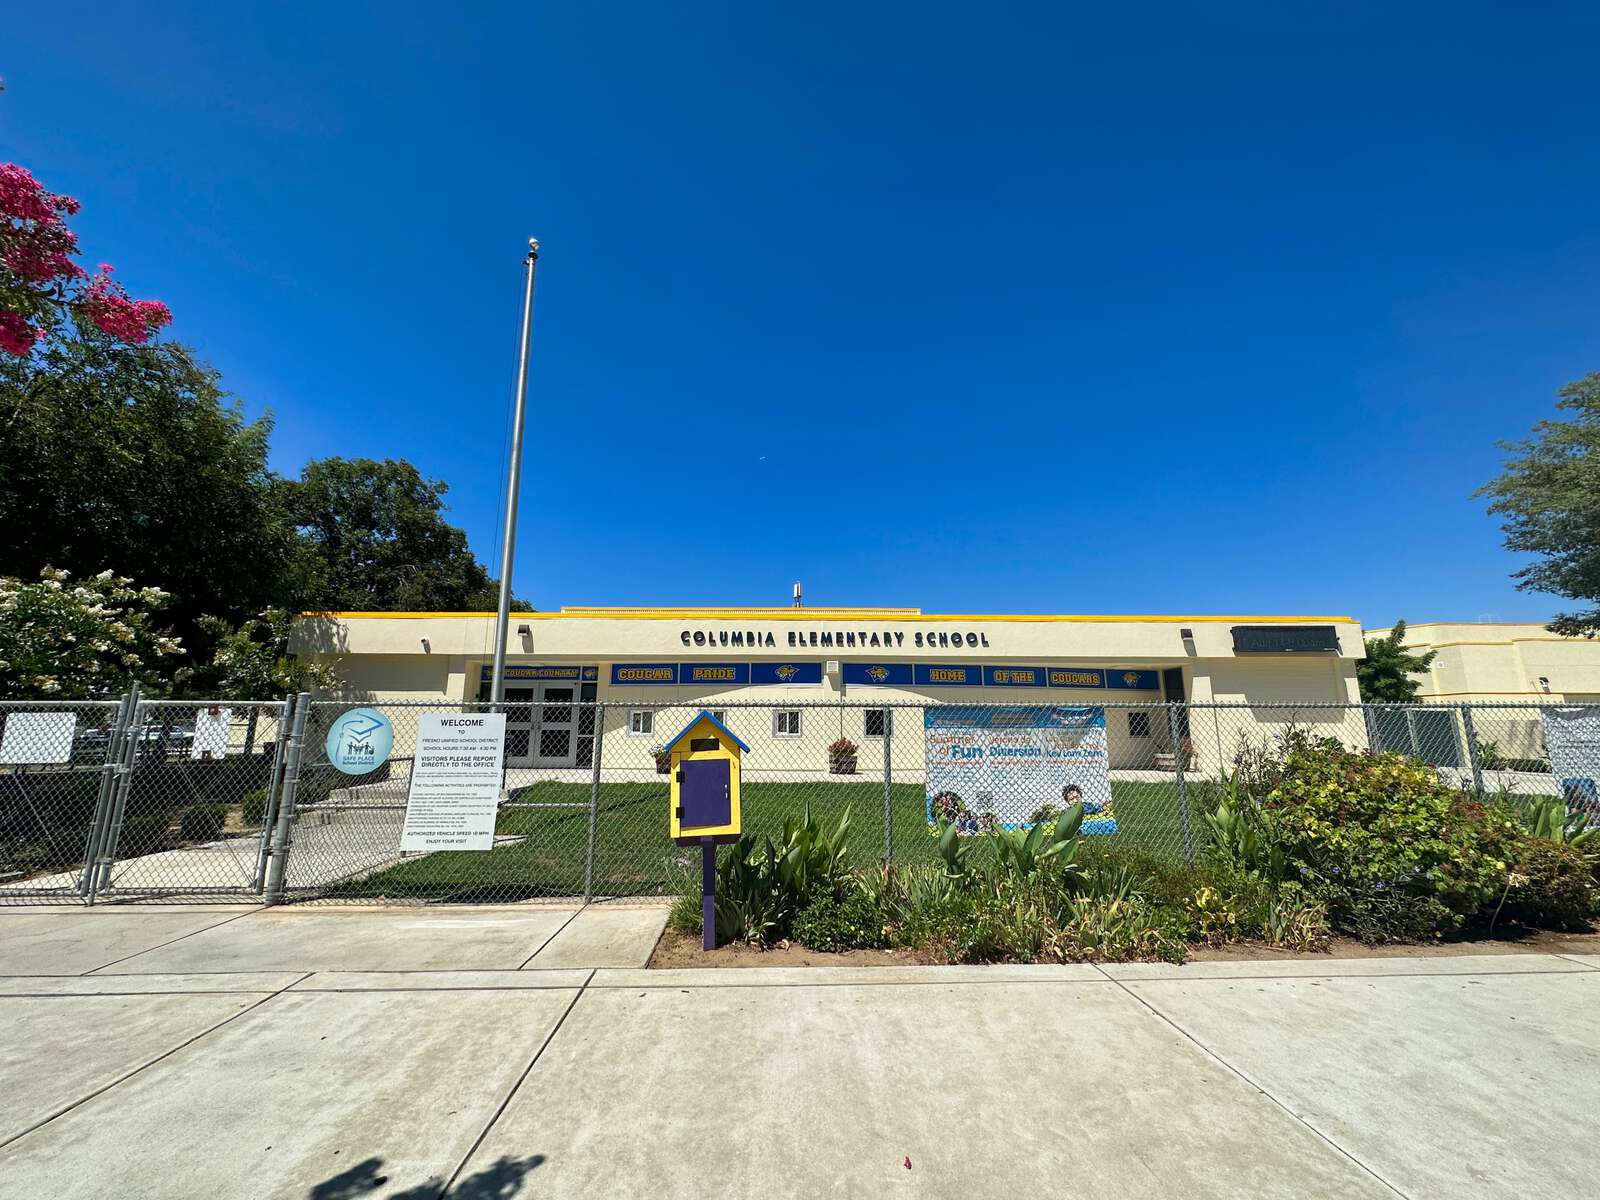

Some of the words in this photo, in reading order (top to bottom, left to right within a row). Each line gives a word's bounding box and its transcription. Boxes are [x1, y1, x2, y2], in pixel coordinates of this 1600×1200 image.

[681, 630, 776, 647] COLUMBIA
[788, 631, 904, 648] ELEMENTARY
[914, 631, 989, 648] SCHOOL
[618, 668, 673, 680] COUGAR
[693, 667, 736, 680] PRIDE
[930, 669, 966, 682] HOME
[994, 670, 1010, 683] OF
[1010, 671, 1035, 684] THE
[1051, 672, 1099, 685] COUGARS
[440, 719, 484, 727] WELCOME
[951, 745, 984, 758] Fun
